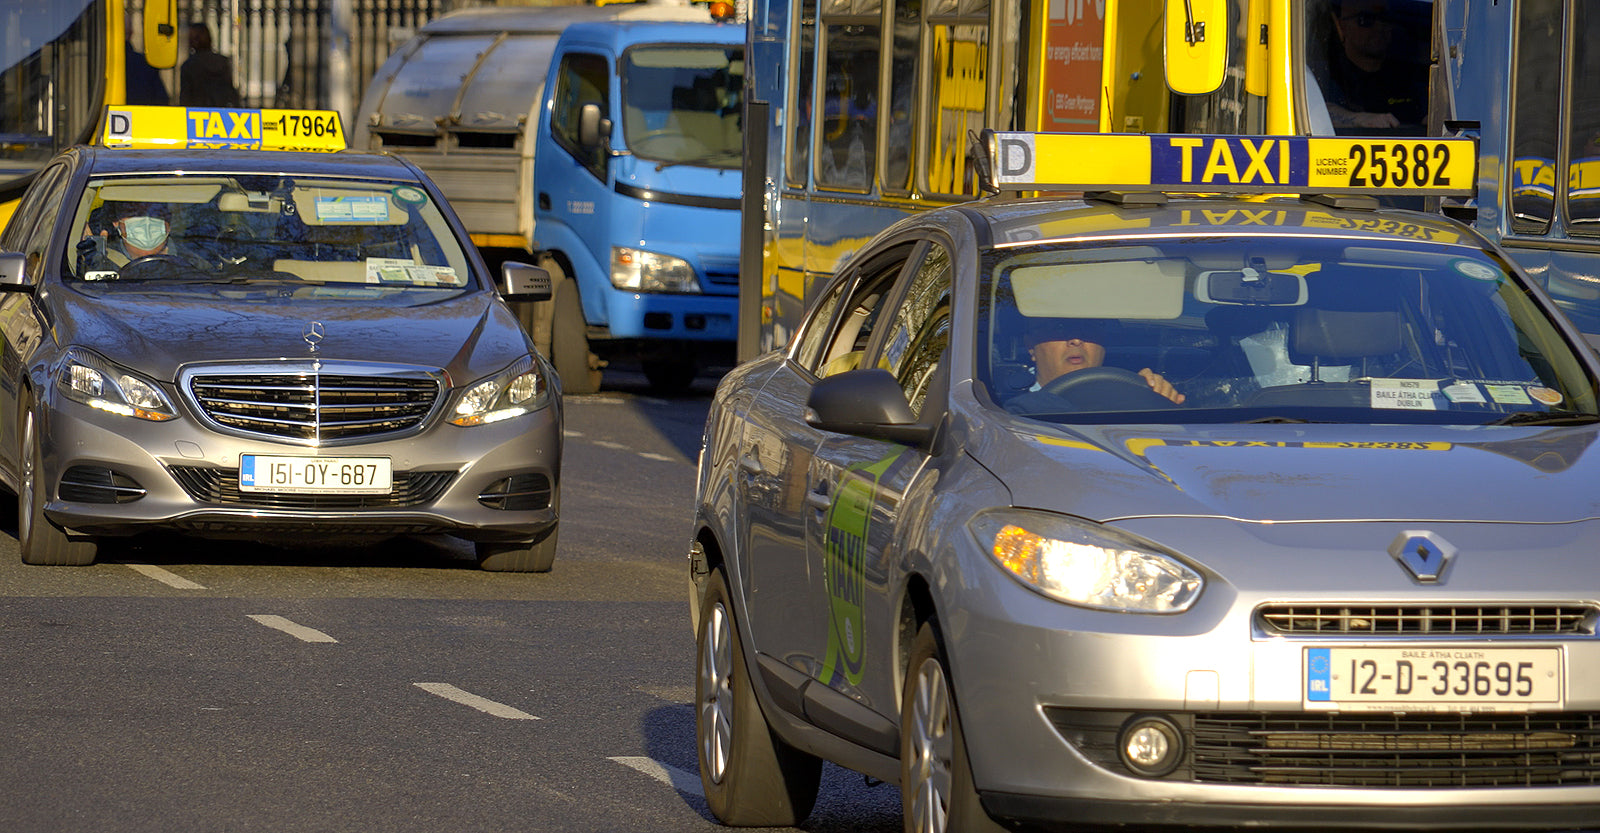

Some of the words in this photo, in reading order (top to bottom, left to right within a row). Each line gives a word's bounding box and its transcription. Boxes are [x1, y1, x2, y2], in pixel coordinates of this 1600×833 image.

[111, 114, 129, 134] D
[188, 111, 261, 139] TAXI
[278, 115, 337, 137] 17964
[1001, 139, 1032, 176] D
[1170, 138, 1290, 184] TAXI
[1316, 158, 1347, 166] LICENCE
[1349, 143, 1450, 187] 25382
[1316, 168, 1347, 176] NUMBER
[1376, 390, 1397, 398] BAILE
[243, 474, 254, 482] IRL
[270, 463, 377, 485] 151-OY-687
[830, 526, 863, 608] TAXI
[1454, 651, 1484, 659] CLIATH
[1310, 680, 1328, 692] IRL
[1350, 659, 1533, 697] 12-D-33695
